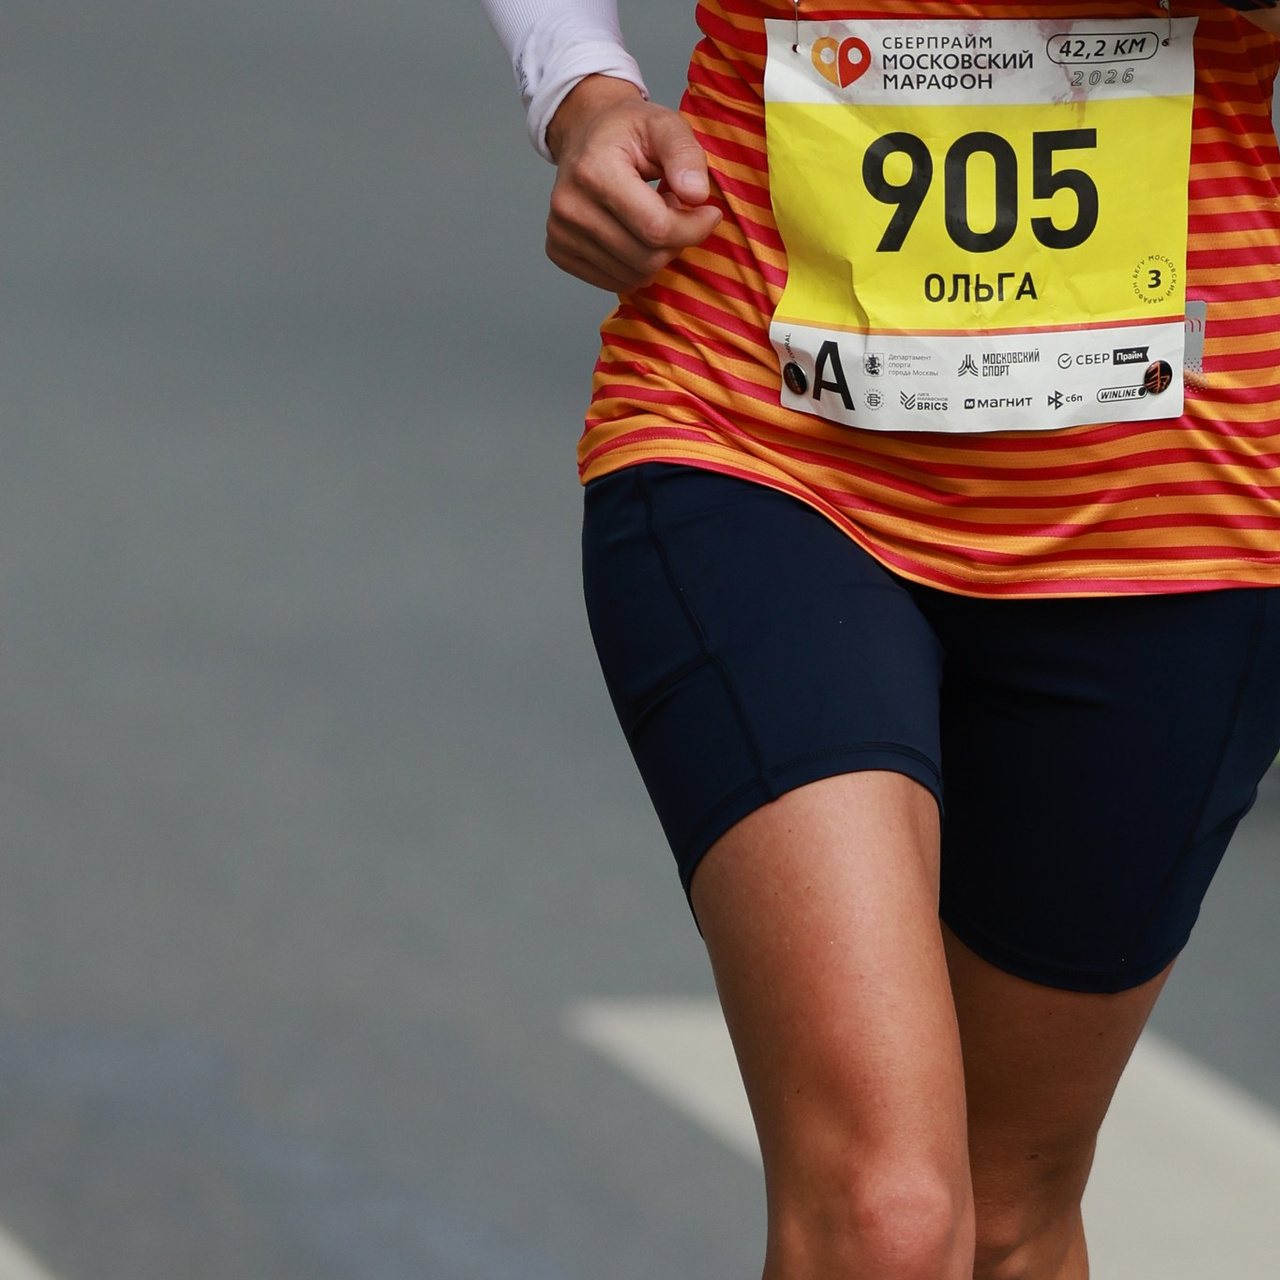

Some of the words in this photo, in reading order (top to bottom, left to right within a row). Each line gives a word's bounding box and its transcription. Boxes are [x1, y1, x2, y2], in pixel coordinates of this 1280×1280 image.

[882, 33, 993, 50] СБЕРПРАЙМ
[1058, 40, 1106, 59] 42,2
[882, 50, 1034, 70] МОСКОВСКИЙ
[882, 73, 993, 90] МАРАФОН
[1070, 67, 1136, 87] 2026
[861, 127, 1099, 253] 905
[924, 271, 1038, 303] ОЛЬГА
[1147, 269, 1162, 289] 3
[982, 348, 1040, 364] МОСКОВСКИЙ
[1076, 353, 1110, 365] СБЕР
[1116, 351, 1143, 362] Прайм
[982, 365, 1010, 377] СПОРТ
[977, 397, 1033, 409] магнит
[1065, 393, 1083, 403] сбп
[1100, 388, 1137, 401] WINLINE
[917, 402, 948, 411] BRICS
